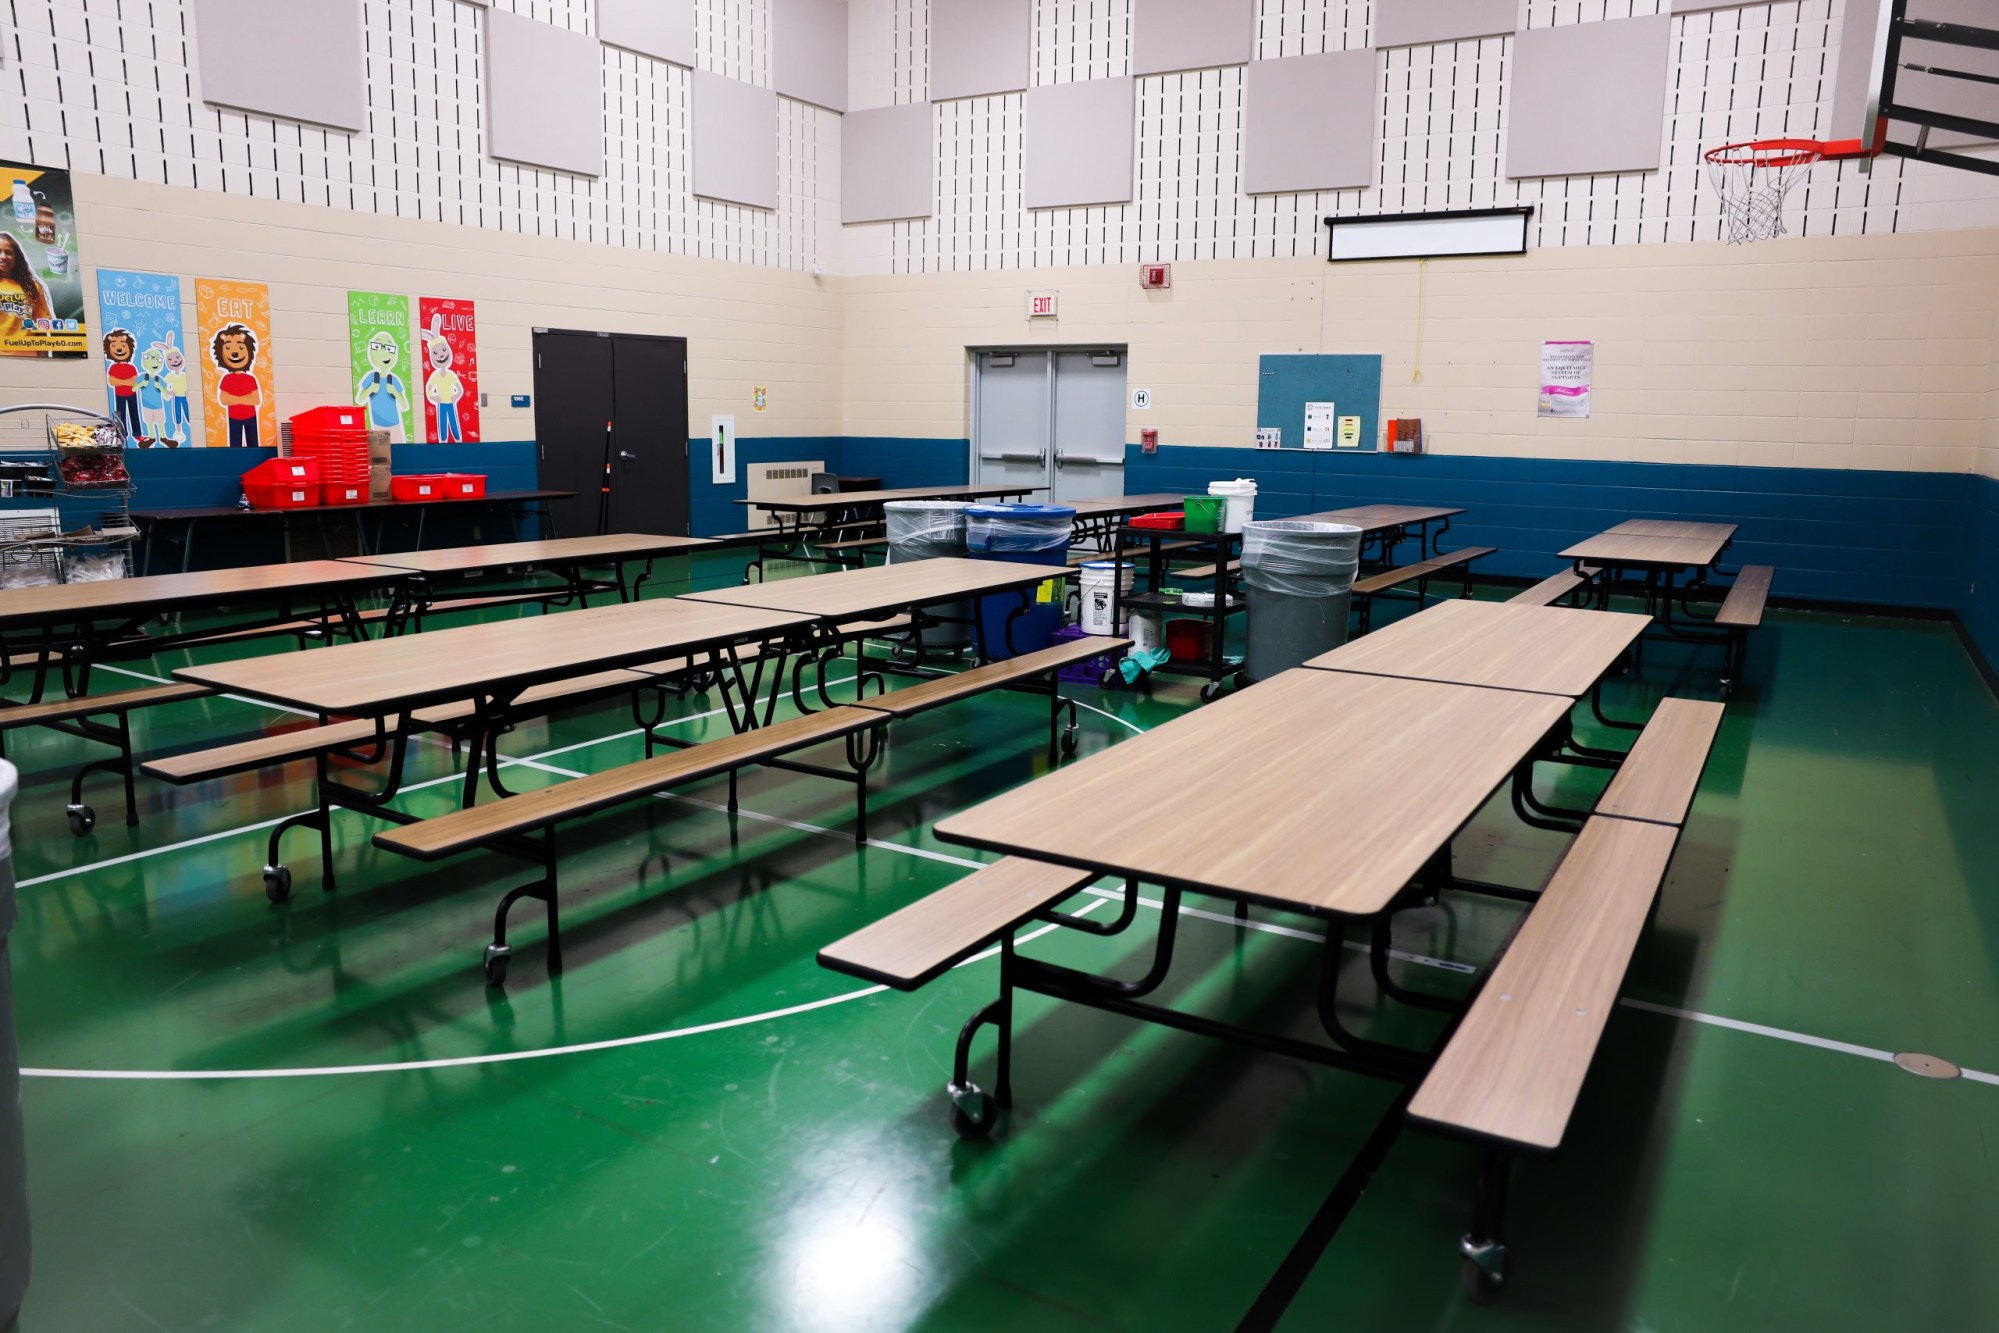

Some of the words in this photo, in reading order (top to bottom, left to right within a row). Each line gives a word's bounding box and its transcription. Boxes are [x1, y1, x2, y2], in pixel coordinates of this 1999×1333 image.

[103, 290, 176, 310] WELCOME
[217, 297, 254, 319] EAT
[1033, 297, 1052, 313] EXIT
[358, 308, 404, 326] LEARN
[442, 314, 474, 332] LIVE
[4, 339, 83, 348] FuelUpToPlay60.com
[1137, 393, 1145, 403] H
